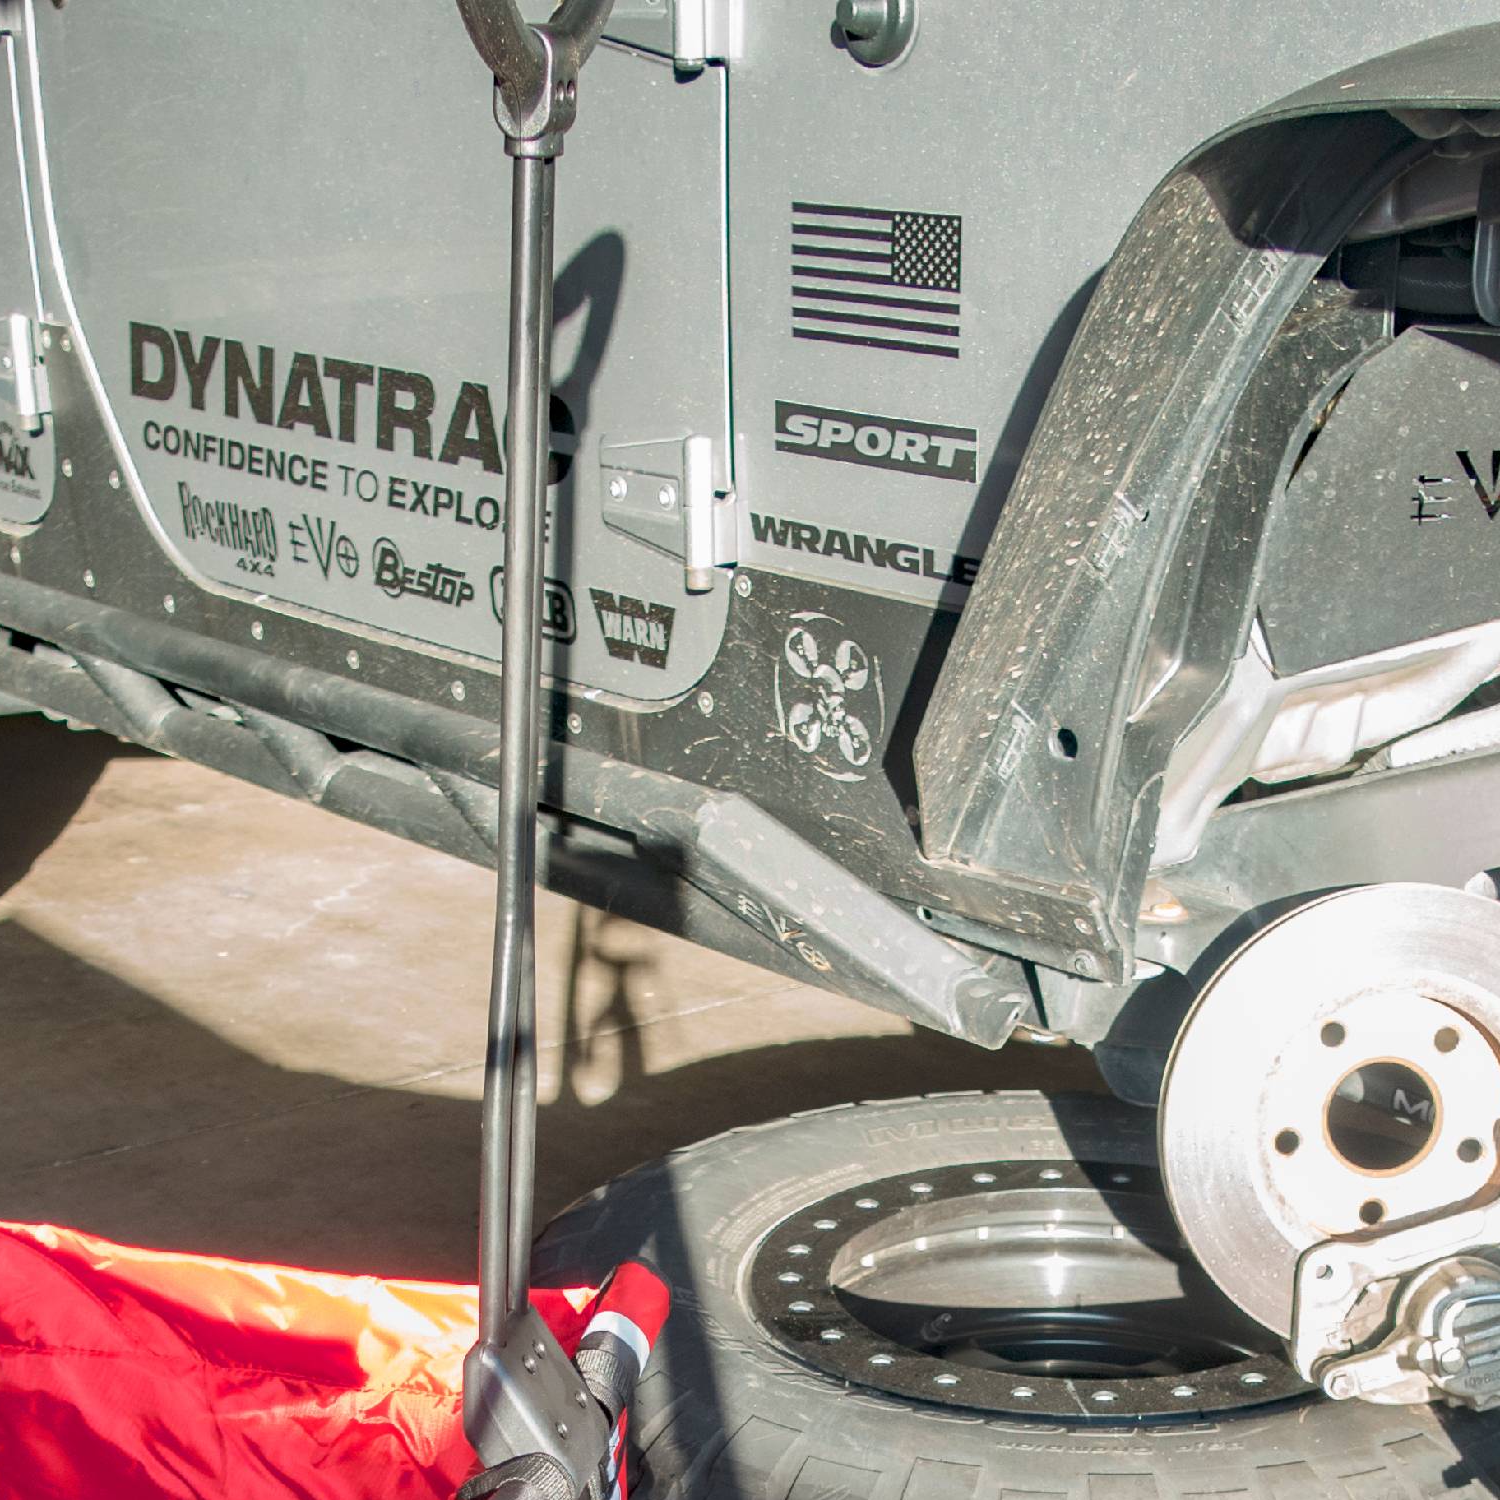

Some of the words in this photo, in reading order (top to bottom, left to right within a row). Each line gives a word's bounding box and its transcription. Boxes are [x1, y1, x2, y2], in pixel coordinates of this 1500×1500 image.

[143, 419, 328, 490] CONFIDENCE
[337, 465, 379, 503] TO
[784, 412, 976, 470] SPORT
[749, 511, 982, 589] WRANGLE
[601, 609, 668, 654] WARN
